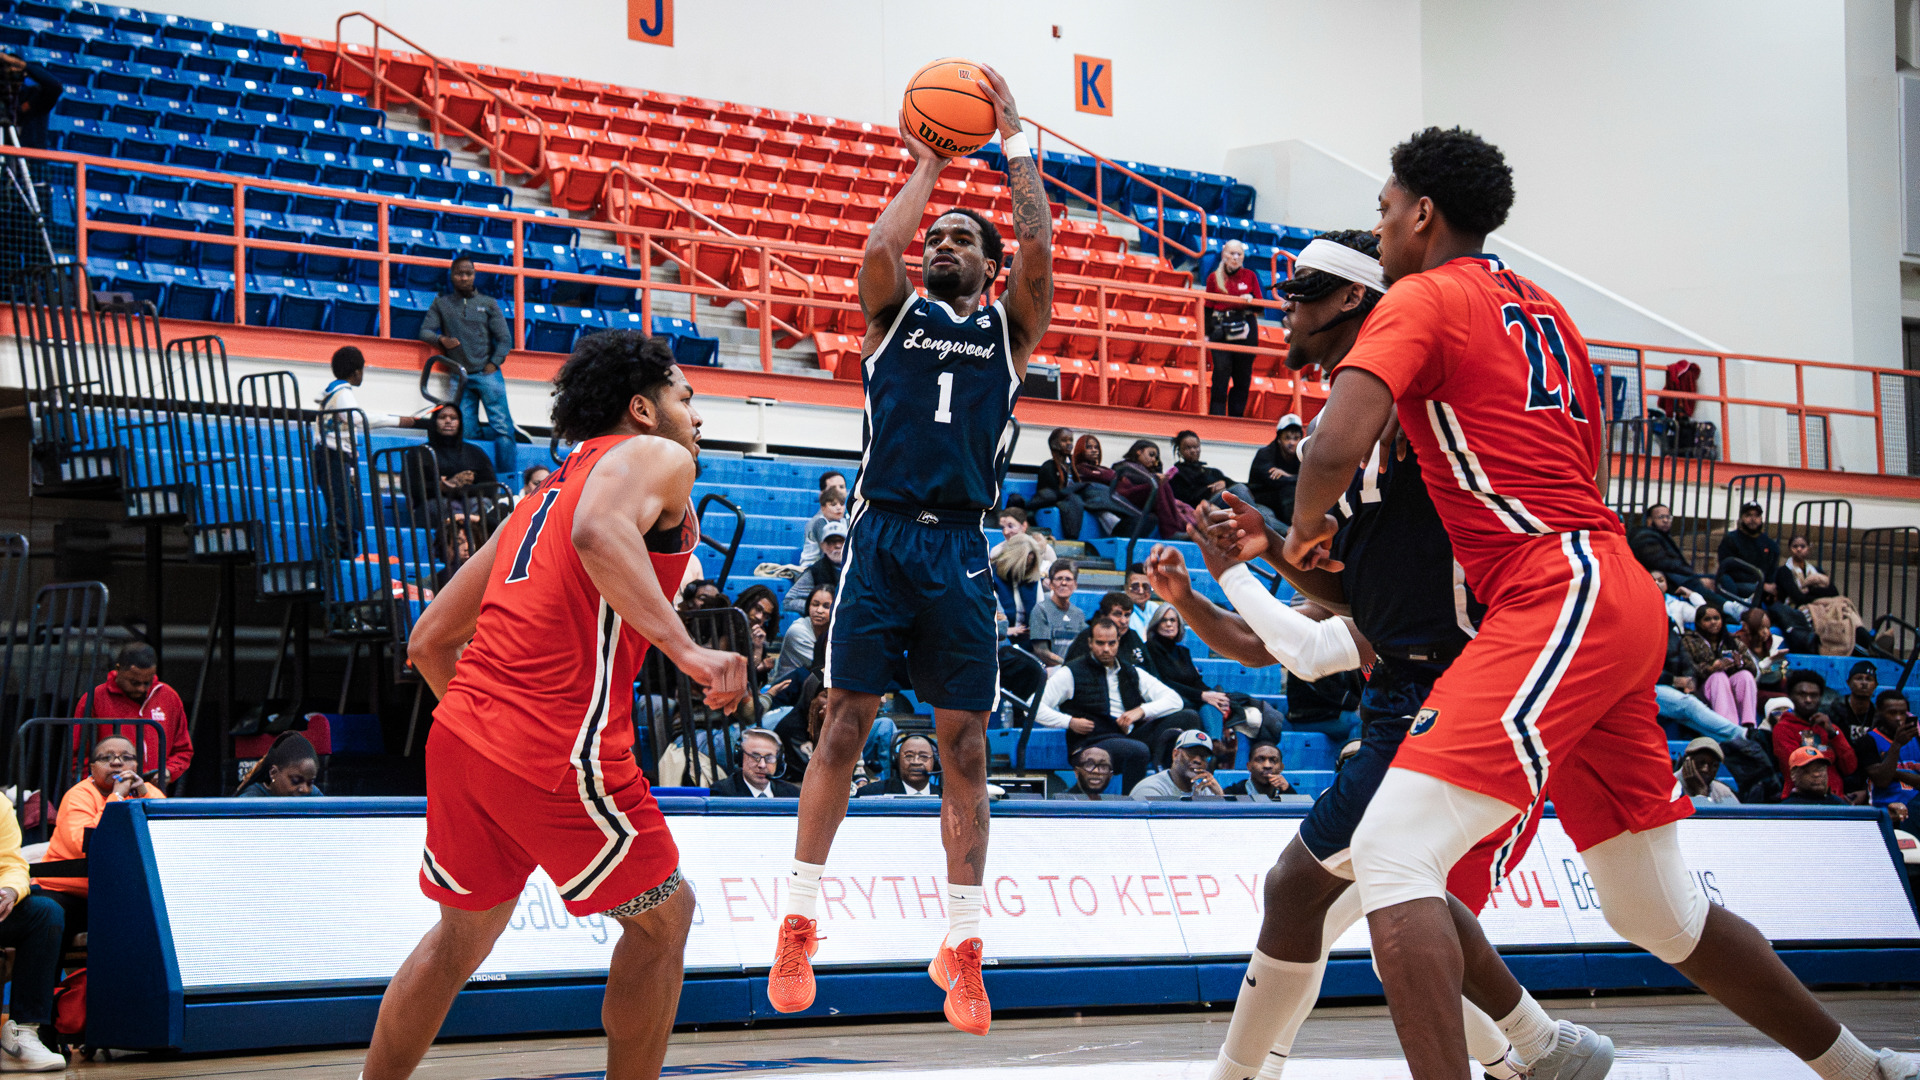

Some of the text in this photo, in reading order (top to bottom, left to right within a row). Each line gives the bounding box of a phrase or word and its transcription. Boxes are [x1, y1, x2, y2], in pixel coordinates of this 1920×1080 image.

[639, 0, 663, 37] J
[1081, 61, 1106, 108] K
[919, 121, 980, 153] Wilson
[903, 328, 996, 360] Longwood
[1501, 302, 1589, 423] 21
[934, 371, 954, 424] 1
[505, 488, 561, 584] 1
[719, 875, 1026, 922] EVRYTHG
[1038, 874, 1098, 917] TO
[1112, 874, 1221, 917] KEEP
[1235, 873, 1260, 914] Y
[1562, 858, 1602, 910] Be
[470, 973, 507, 982] TRONICS
